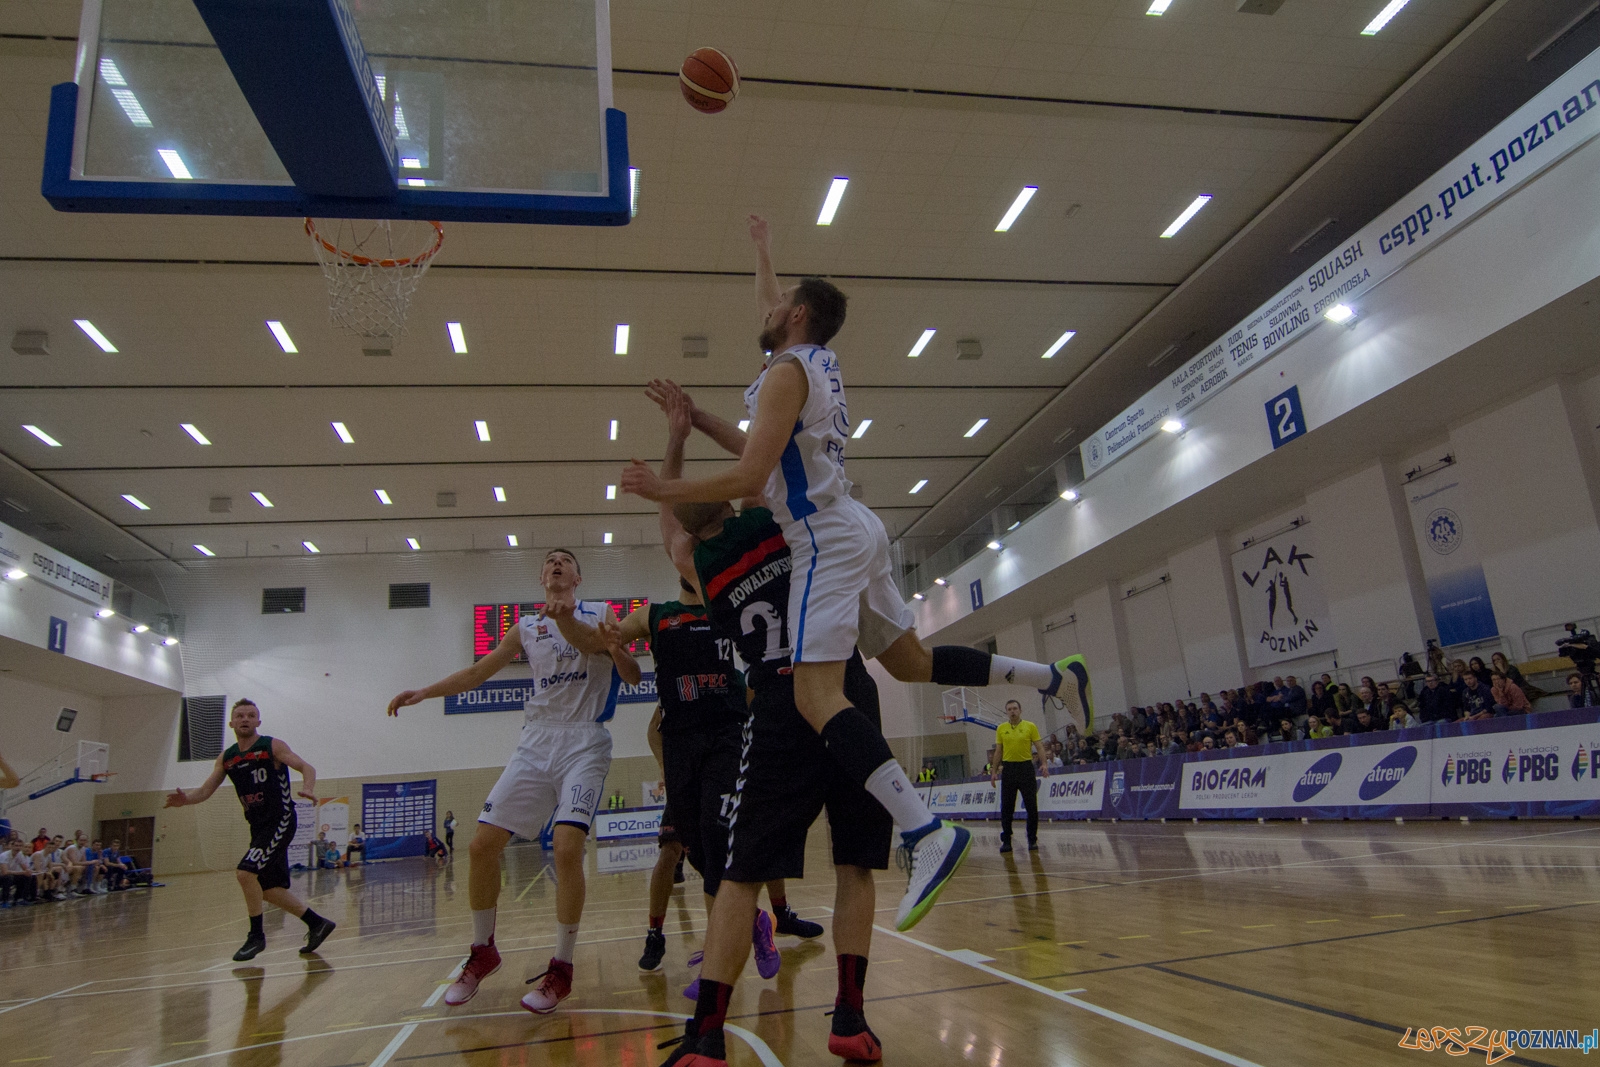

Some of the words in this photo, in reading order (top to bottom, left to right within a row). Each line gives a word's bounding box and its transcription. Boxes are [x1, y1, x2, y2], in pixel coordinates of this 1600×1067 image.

[1308, 240, 1364, 292] SQUASH
[1313, 268, 1371, 314] ERGOWIOSŁA
[1269, 300, 1302, 328] SIŁOWNIA
[1227, 329, 1244, 347] JUDO
[1262, 308, 1310, 350] BOWLING
[1230, 333, 1258, 361] TENIS
[1171, 371, 1189, 389] HALA
[1188, 344, 1224, 377] SPORTOWA
[1200, 367, 1229, 394] AEROBIK
[1104, 420, 1127, 441] Centrum
[1126, 408, 1145, 426] Sportu
[1273, 397, 1296, 440] 2
[1107, 430, 1137, 455] Politechniki
[32, 552, 111, 600] cspp.put.poznan.pl
[972, 585, 980, 607] 1
[54, 622, 62, 650] 1
[1260, 618, 1319, 653] POZNAŃ
[552, 642, 580, 662] 14
[714, 638, 731, 661] 12
[696, 673, 728, 688] PEC
[457, 687, 534, 706] POLITECH
[1456, 750, 1492, 759] fundacja
[1518, 744, 1560, 754] fundacja
[250, 767, 268, 784] 10
[1191, 766, 1267, 791] BIOFARM
[1300, 770, 1332, 786] atrem
[1367, 766, 1405, 783] atrem
[1456, 758, 1492, 784] PBG
[1518, 753, 1559, 782] PBG
[571, 784, 595, 809] 14
[1050, 779, 1096, 797] BIOFARM
[245, 847, 263, 862] 10
